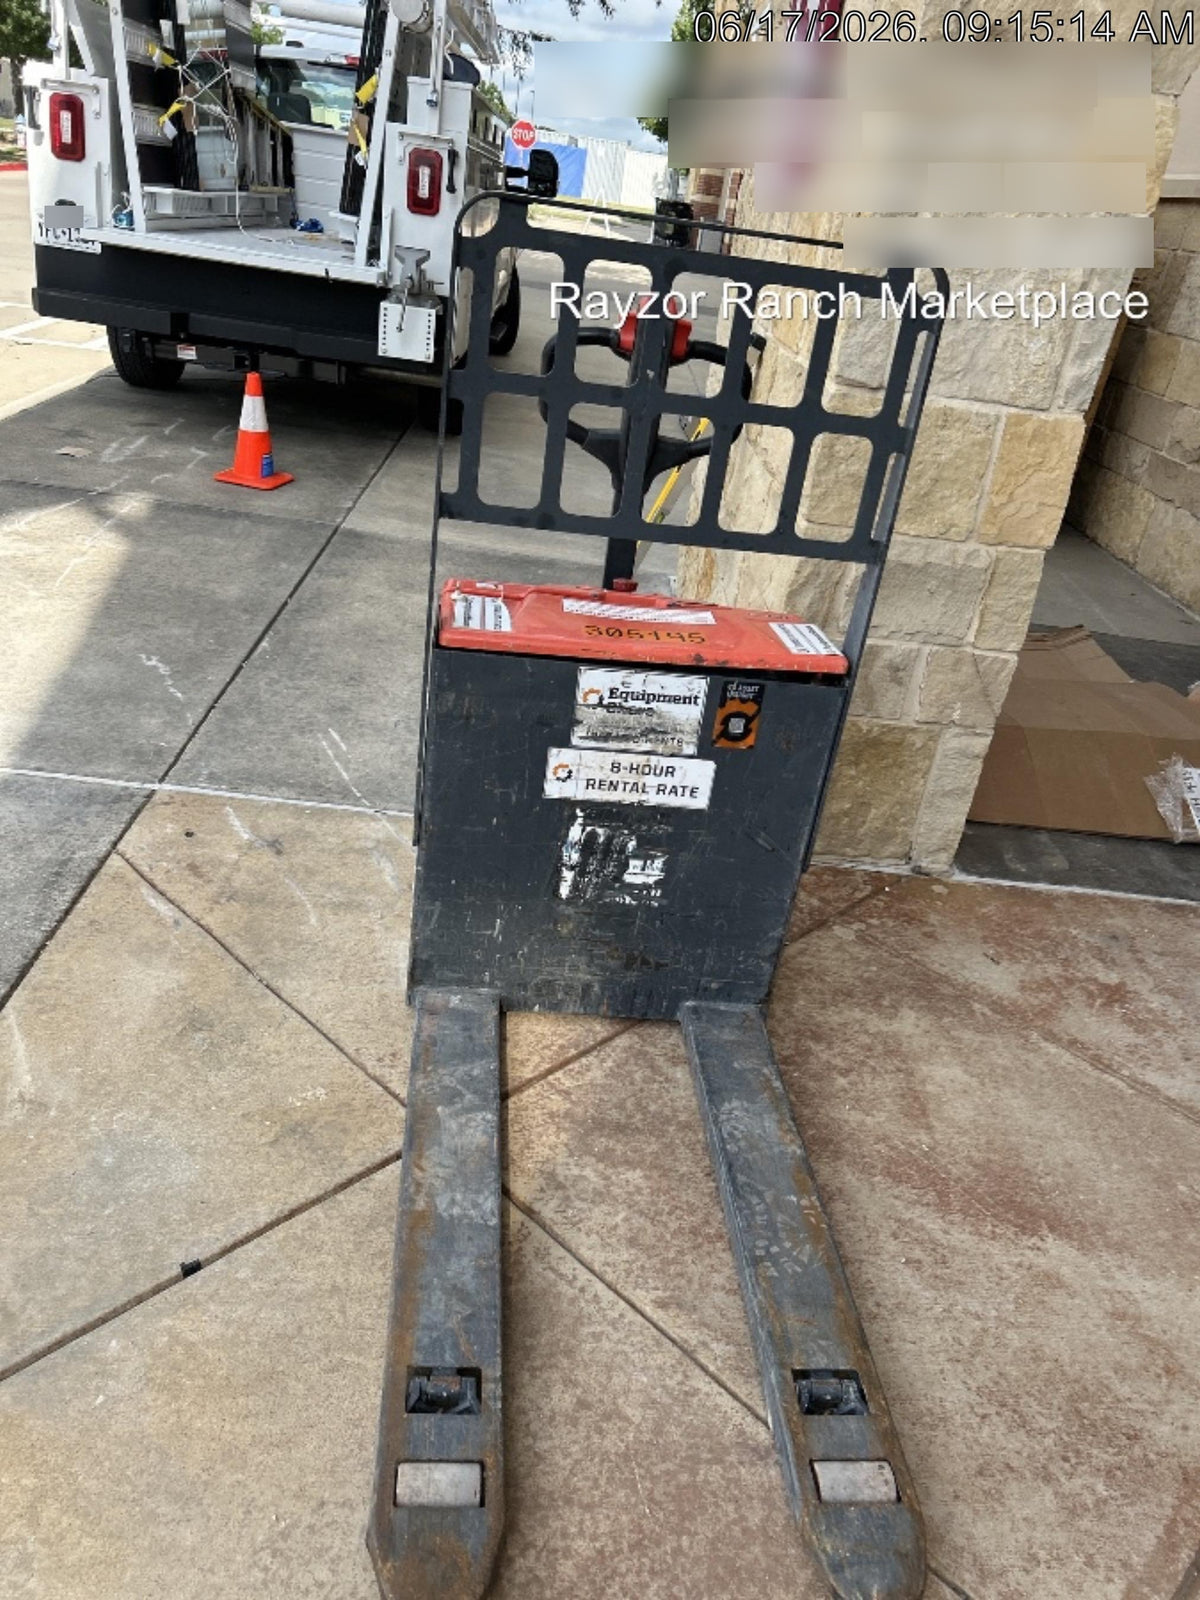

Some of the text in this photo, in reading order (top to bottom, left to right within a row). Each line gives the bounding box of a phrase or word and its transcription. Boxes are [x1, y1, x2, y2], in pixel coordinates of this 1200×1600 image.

[513, 128, 535, 141] STOP
[608, 687, 700, 706] Equipment
[610, 762, 676, 778] 8-HOUR
[586, 778, 700, 798] RENTAL RATE
